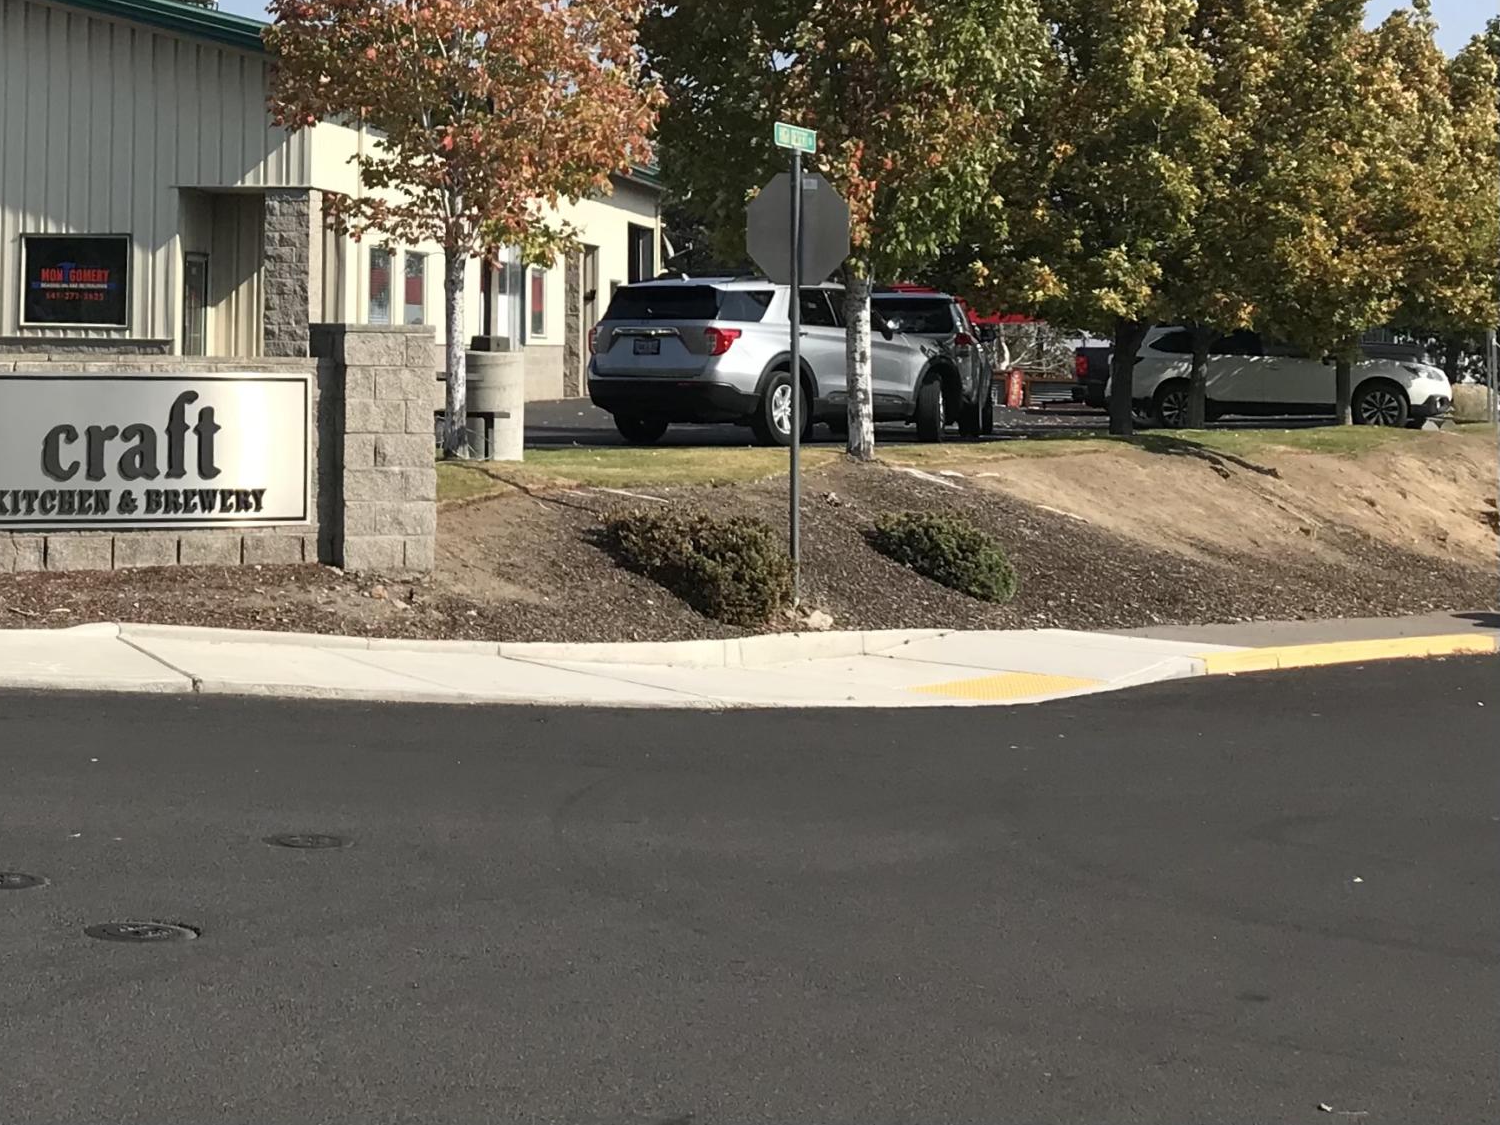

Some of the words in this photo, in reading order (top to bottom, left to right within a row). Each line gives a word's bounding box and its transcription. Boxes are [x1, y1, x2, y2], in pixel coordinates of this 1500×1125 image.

[40, 390, 222, 482] craft
[116, 489, 138, 515] &
[143, 488, 267, 514] BREWERY
